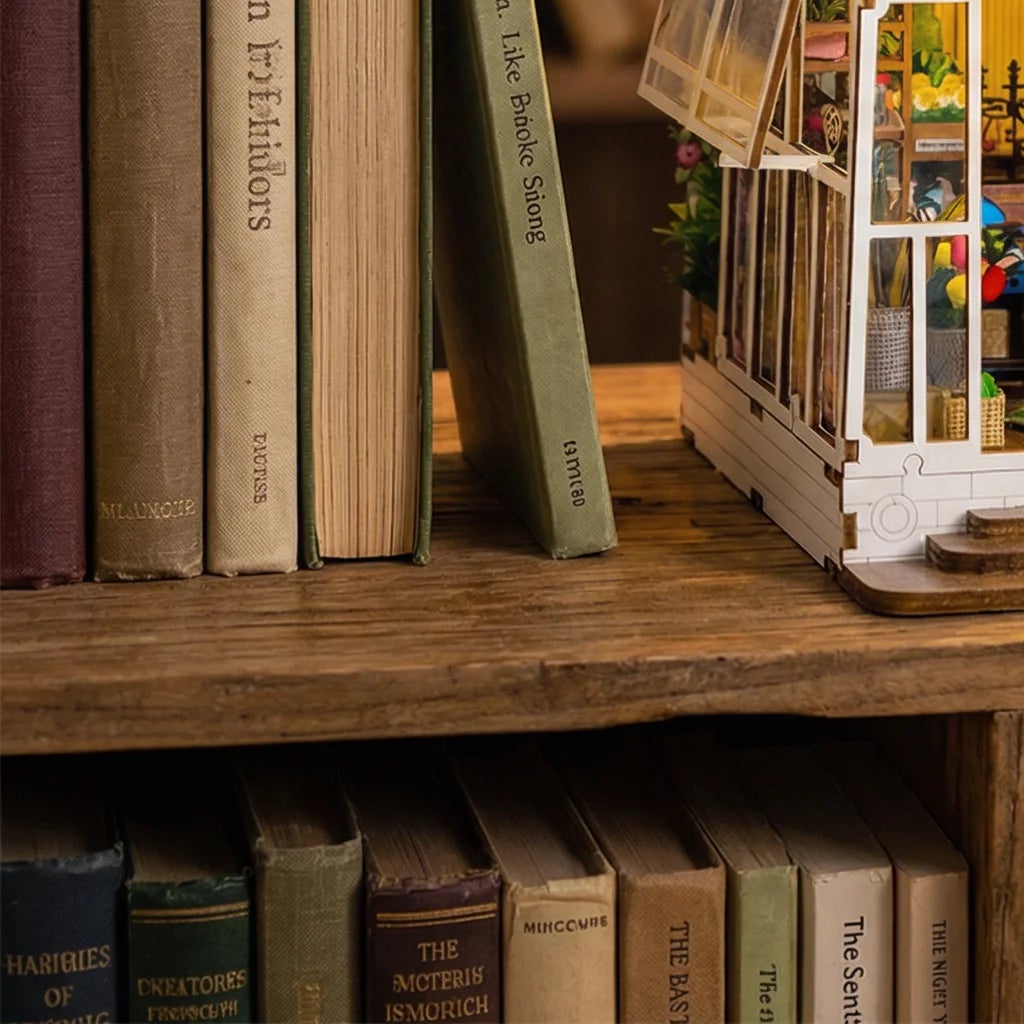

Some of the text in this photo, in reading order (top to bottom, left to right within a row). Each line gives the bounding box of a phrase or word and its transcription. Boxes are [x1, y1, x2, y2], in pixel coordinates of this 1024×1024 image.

[502, 31, 525, 84] Like
[417, 939, 460, 962] THE
[669, 920, 690, 967] THE
[843, 916, 864, 961] The
[44, 985, 75, 1009] OF
